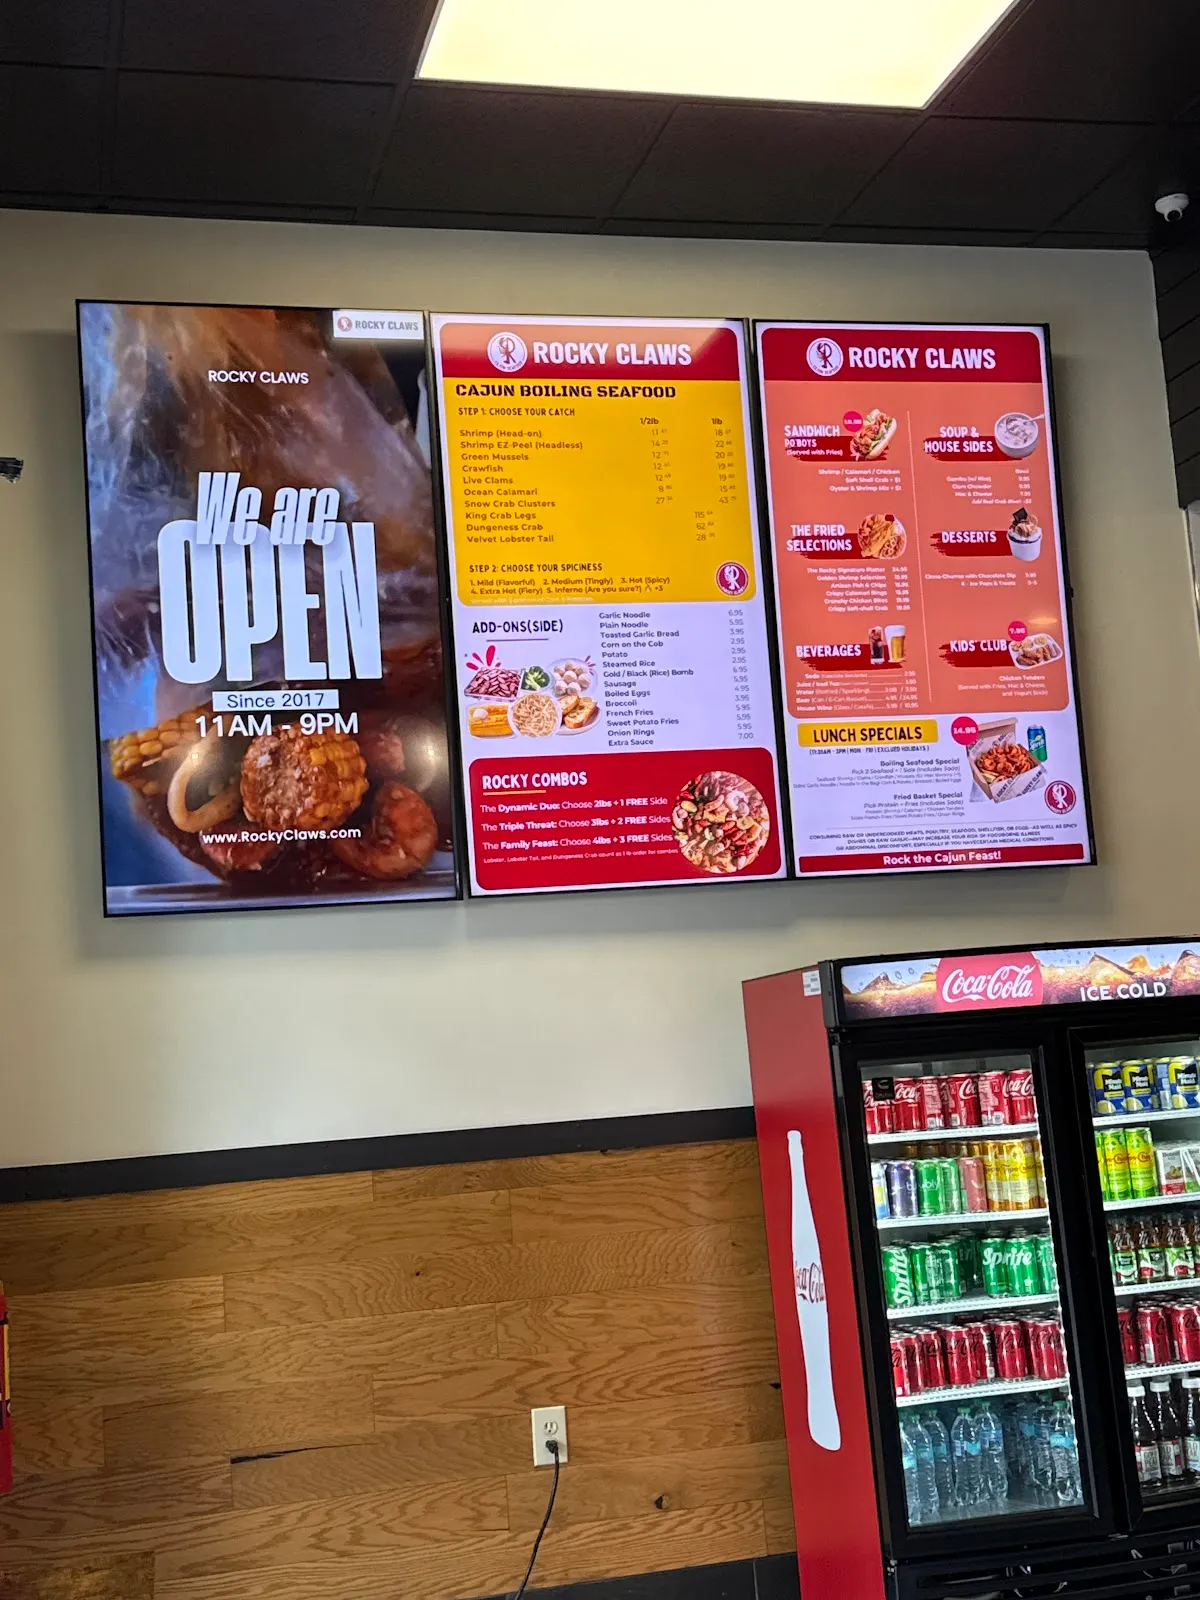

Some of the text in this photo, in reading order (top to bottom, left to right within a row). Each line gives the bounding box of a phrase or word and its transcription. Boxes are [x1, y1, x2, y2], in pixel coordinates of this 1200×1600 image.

[355, 320, 418, 331] ROCKY CLAWS
[534, 342, 608, 364] ROCKY
[616, 343, 692, 366] CLAWS
[849, 347, 996, 369] ROCKY CLAWS
[208, 370, 309, 383] ROCKY CLAWS
[456, 384, 676, 398] CAJUN BOILING SEAFOOD
[525, 408, 546, 416] YOUR
[549, 408, 575, 416] CATCH
[640, 417, 659, 425] 1/2lb
[460, 430, 542, 438] Shrimp (Head-on)
[784, 425, 840, 437] SANDWICH
[940, 426, 979, 437] SOUP &
[461, 441, 494, 450] Shrimp
[536, 442, 583, 450] (Headless)
[925, 441, 993, 452] HOUSE SIDES
[497, 488, 537, 496] Calamari
[196, 472, 340, 545] We are
[466, 512, 486, 520] King
[515, 512, 536, 520] Legs
[466, 524, 518, 532] Dungeness
[791, 525, 845, 536] THE FRIED
[942, 531, 996, 543] DESSERTS
[787, 539, 852, 551] SELECTIONS
[501, 564, 533, 572] CHOOSE
[561, 563, 602, 571] SPICINESS
[158, 520, 382, 684] OPEN
[473, 619, 563, 633] ADD-ONS(SIDE)
[796, 645, 861, 657] BEVERAGES
[980, 640, 1007, 650] CLUB
[227, 693, 324, 708] Since 2017
[196, 714, 272, 737] 11AM
[301, 712, 358, 735] 9PM
[953, 726, 976, 734] 14.95
[813, 727, 922, 743] LUNCH SPECIALS
[482, 772, 588, 789] ROCKY COMBOS
[480, 805, 496, 813] The
[498, 802, 538, 813] Dynamic
[562, 801, 592, 809] Choose
[626, 798, 648, 806] FREE
[650, 797, 668, 805] Side
[499, 822, 525, 832] Triple
[526, 821, 557, 829] Threat:
[558, 819, 590, 828] Choose
[591, 818, 609, 826] 3lbs
[625, 816, 647, 824] FREE
[648, 815, 671, 823] Sides
[203, 829, 361, 844] www.RockyClaws.com
[482, 842, 499, 850] The
[501, 840, 531, 850] Family
[560, 838, 591, 846] Choose
[592, 836, 611, 844] 4lbs
[651, 834, 673, 842] Sides
[883, 850, 1001, 865] Rock the Cajun Feast!
[942, 965, 1037, 1003] Coca-Cola
[1081, 982, 1166, 1001] ICE COLD
